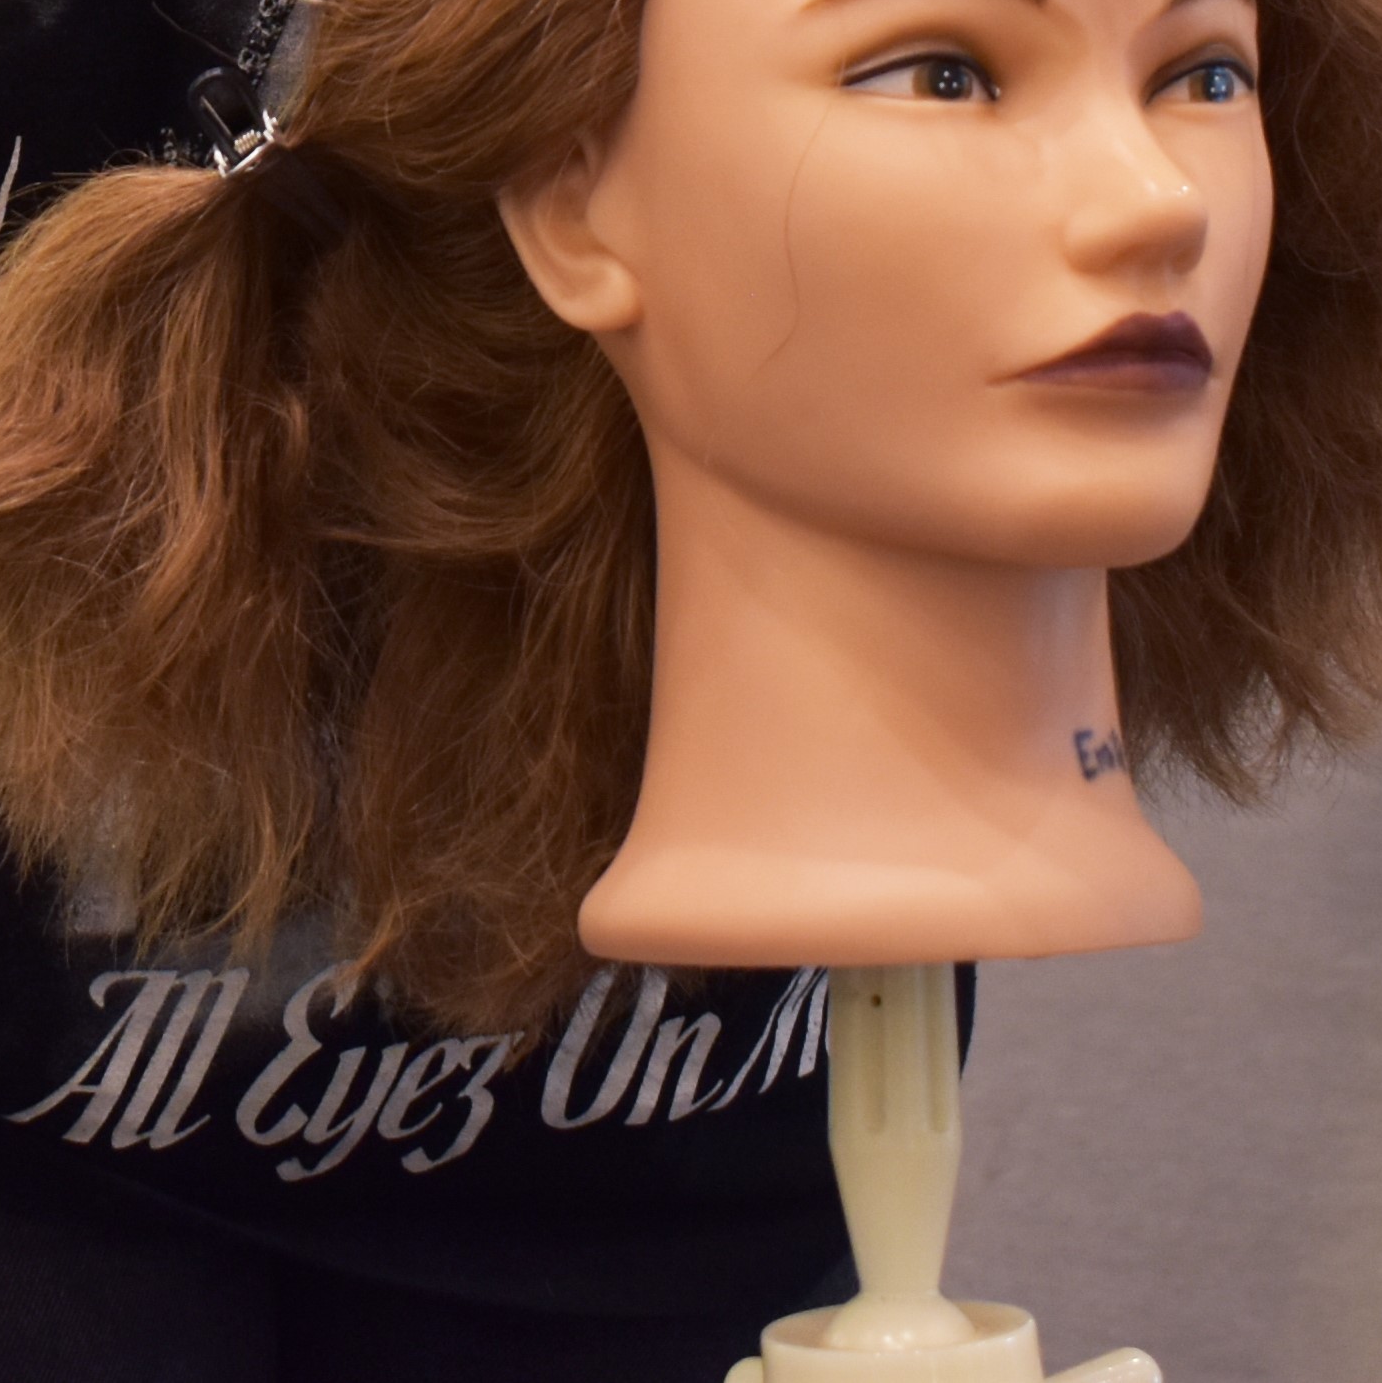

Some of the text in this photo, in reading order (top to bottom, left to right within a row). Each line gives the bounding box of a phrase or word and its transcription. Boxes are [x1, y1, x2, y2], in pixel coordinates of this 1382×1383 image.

[2, 968, 250, 1150] All
[235, 962, 525, 1181] Eyez
[541, 964, 723, 1129] On
